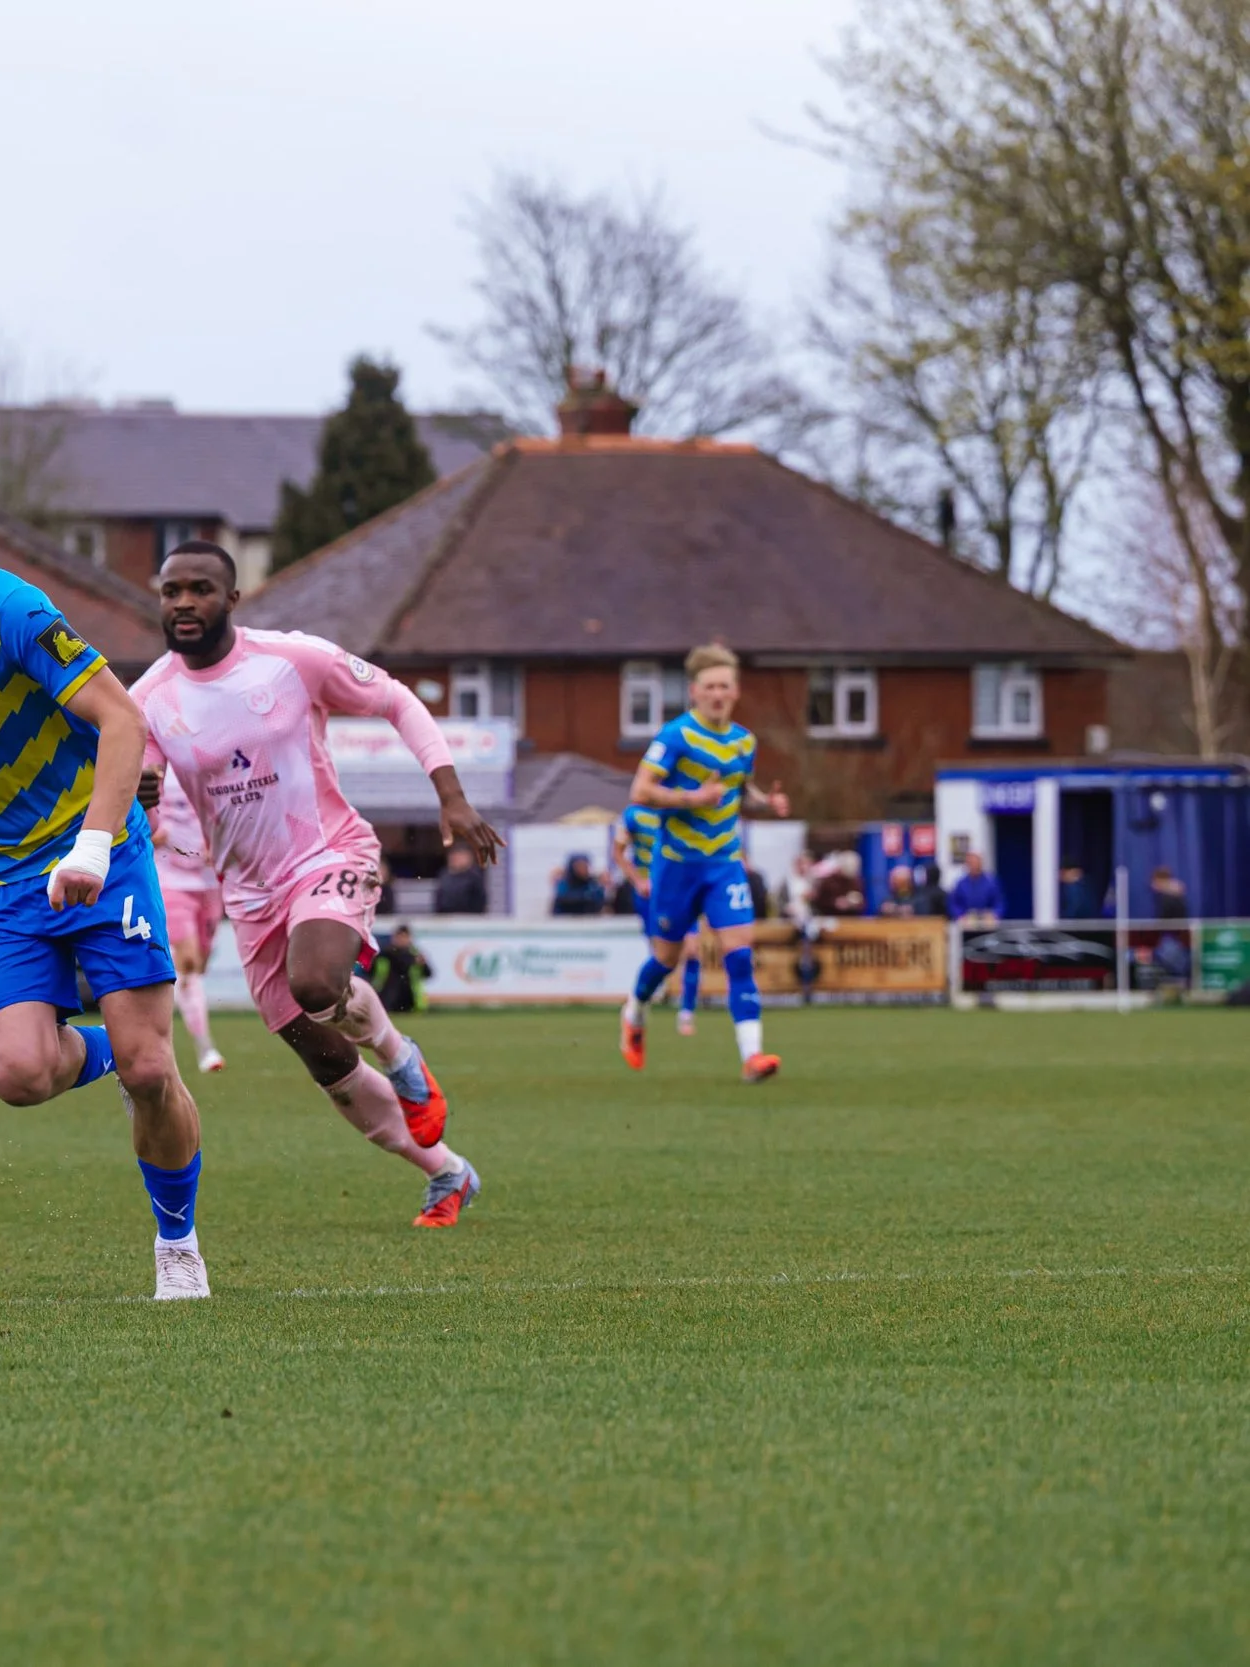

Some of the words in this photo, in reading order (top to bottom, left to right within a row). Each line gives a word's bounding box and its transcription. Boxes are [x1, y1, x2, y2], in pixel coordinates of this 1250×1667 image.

[247, 772, 280, 789] STEELS
[230, 795, 243, 805] UK
[310, 869, 358, 899] 28
[121, 895, 152, 940] 4
